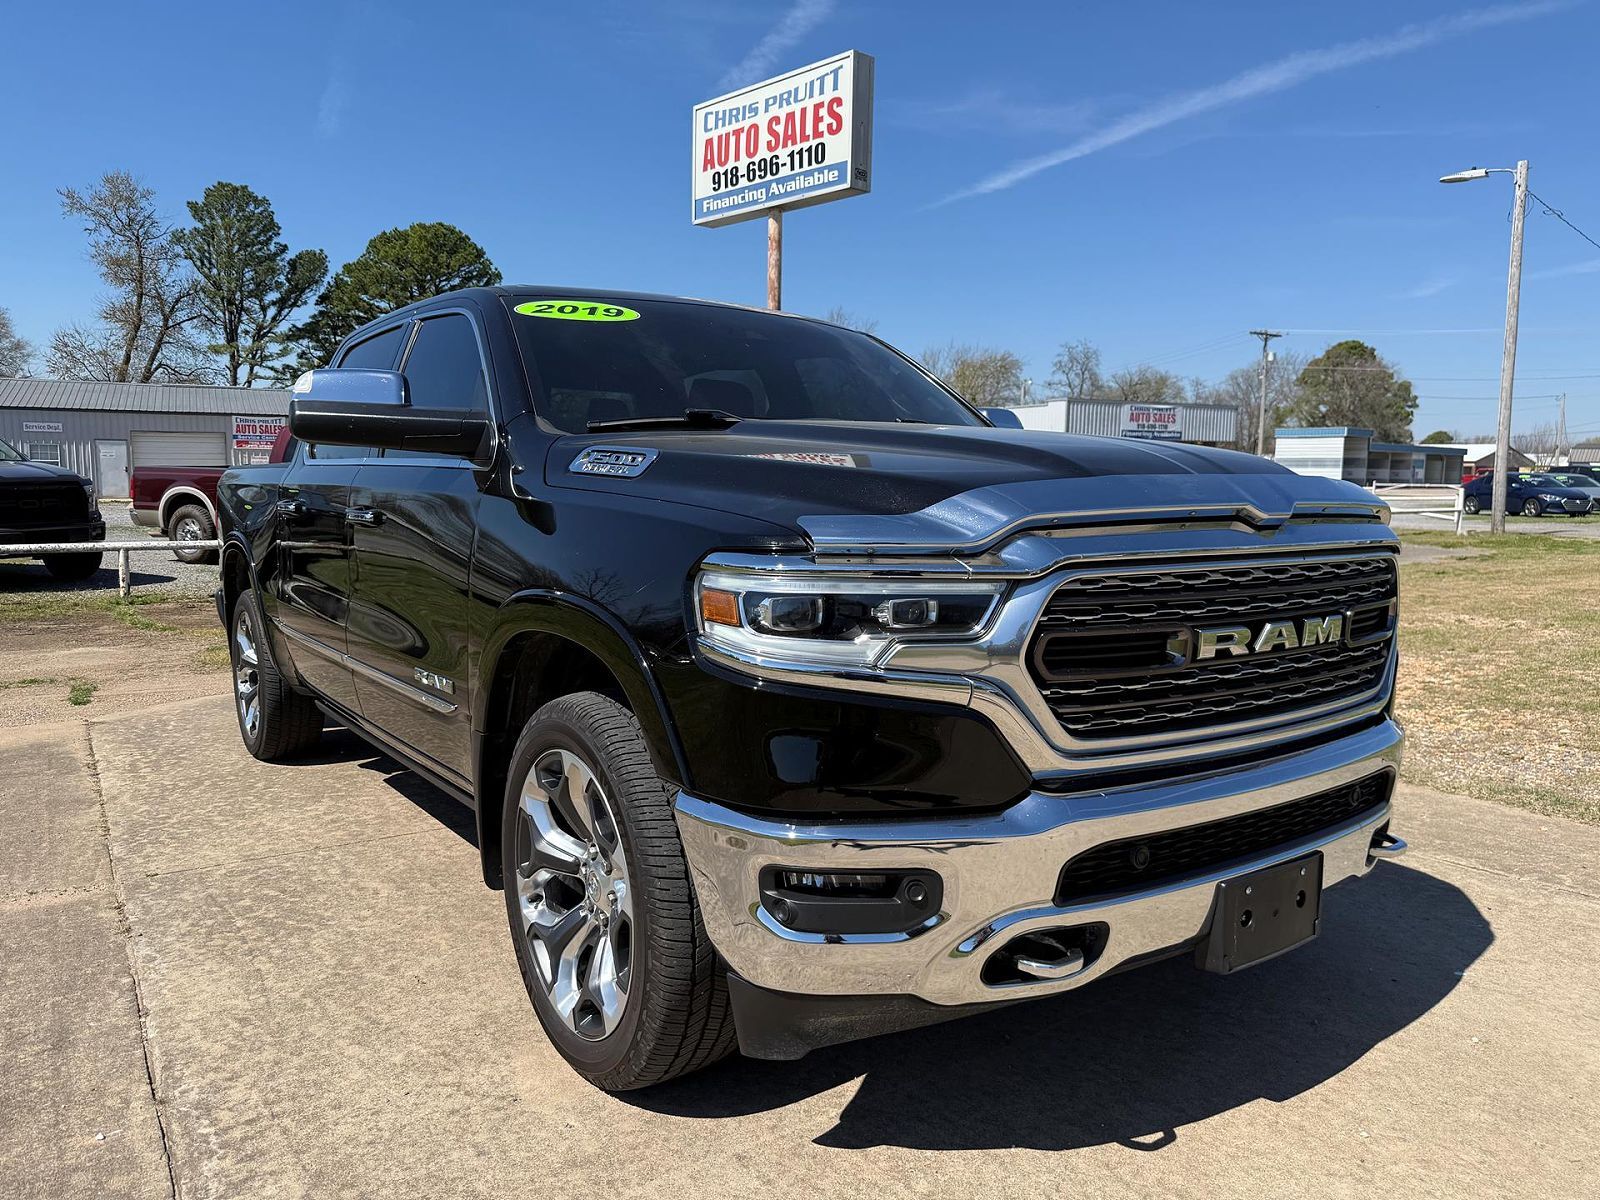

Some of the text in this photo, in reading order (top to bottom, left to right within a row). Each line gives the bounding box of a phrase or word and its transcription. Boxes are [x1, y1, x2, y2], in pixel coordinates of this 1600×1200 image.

[703, 65, 843, 133] CHRIS PRUITT
[702, 97, 843, 173] AUTO SALES
[712, 142, 826, 192] 918-696-1110
[703, 187, 766, 213] Financing
[768, 169, 838, 197] Available
[531, 304, 624, 317] 2019
[235, 424, 257, 433] AUTO
[1129, 412, 1176, 424] AUTO SALES
[1194, 614, 1343, 659] RAM
